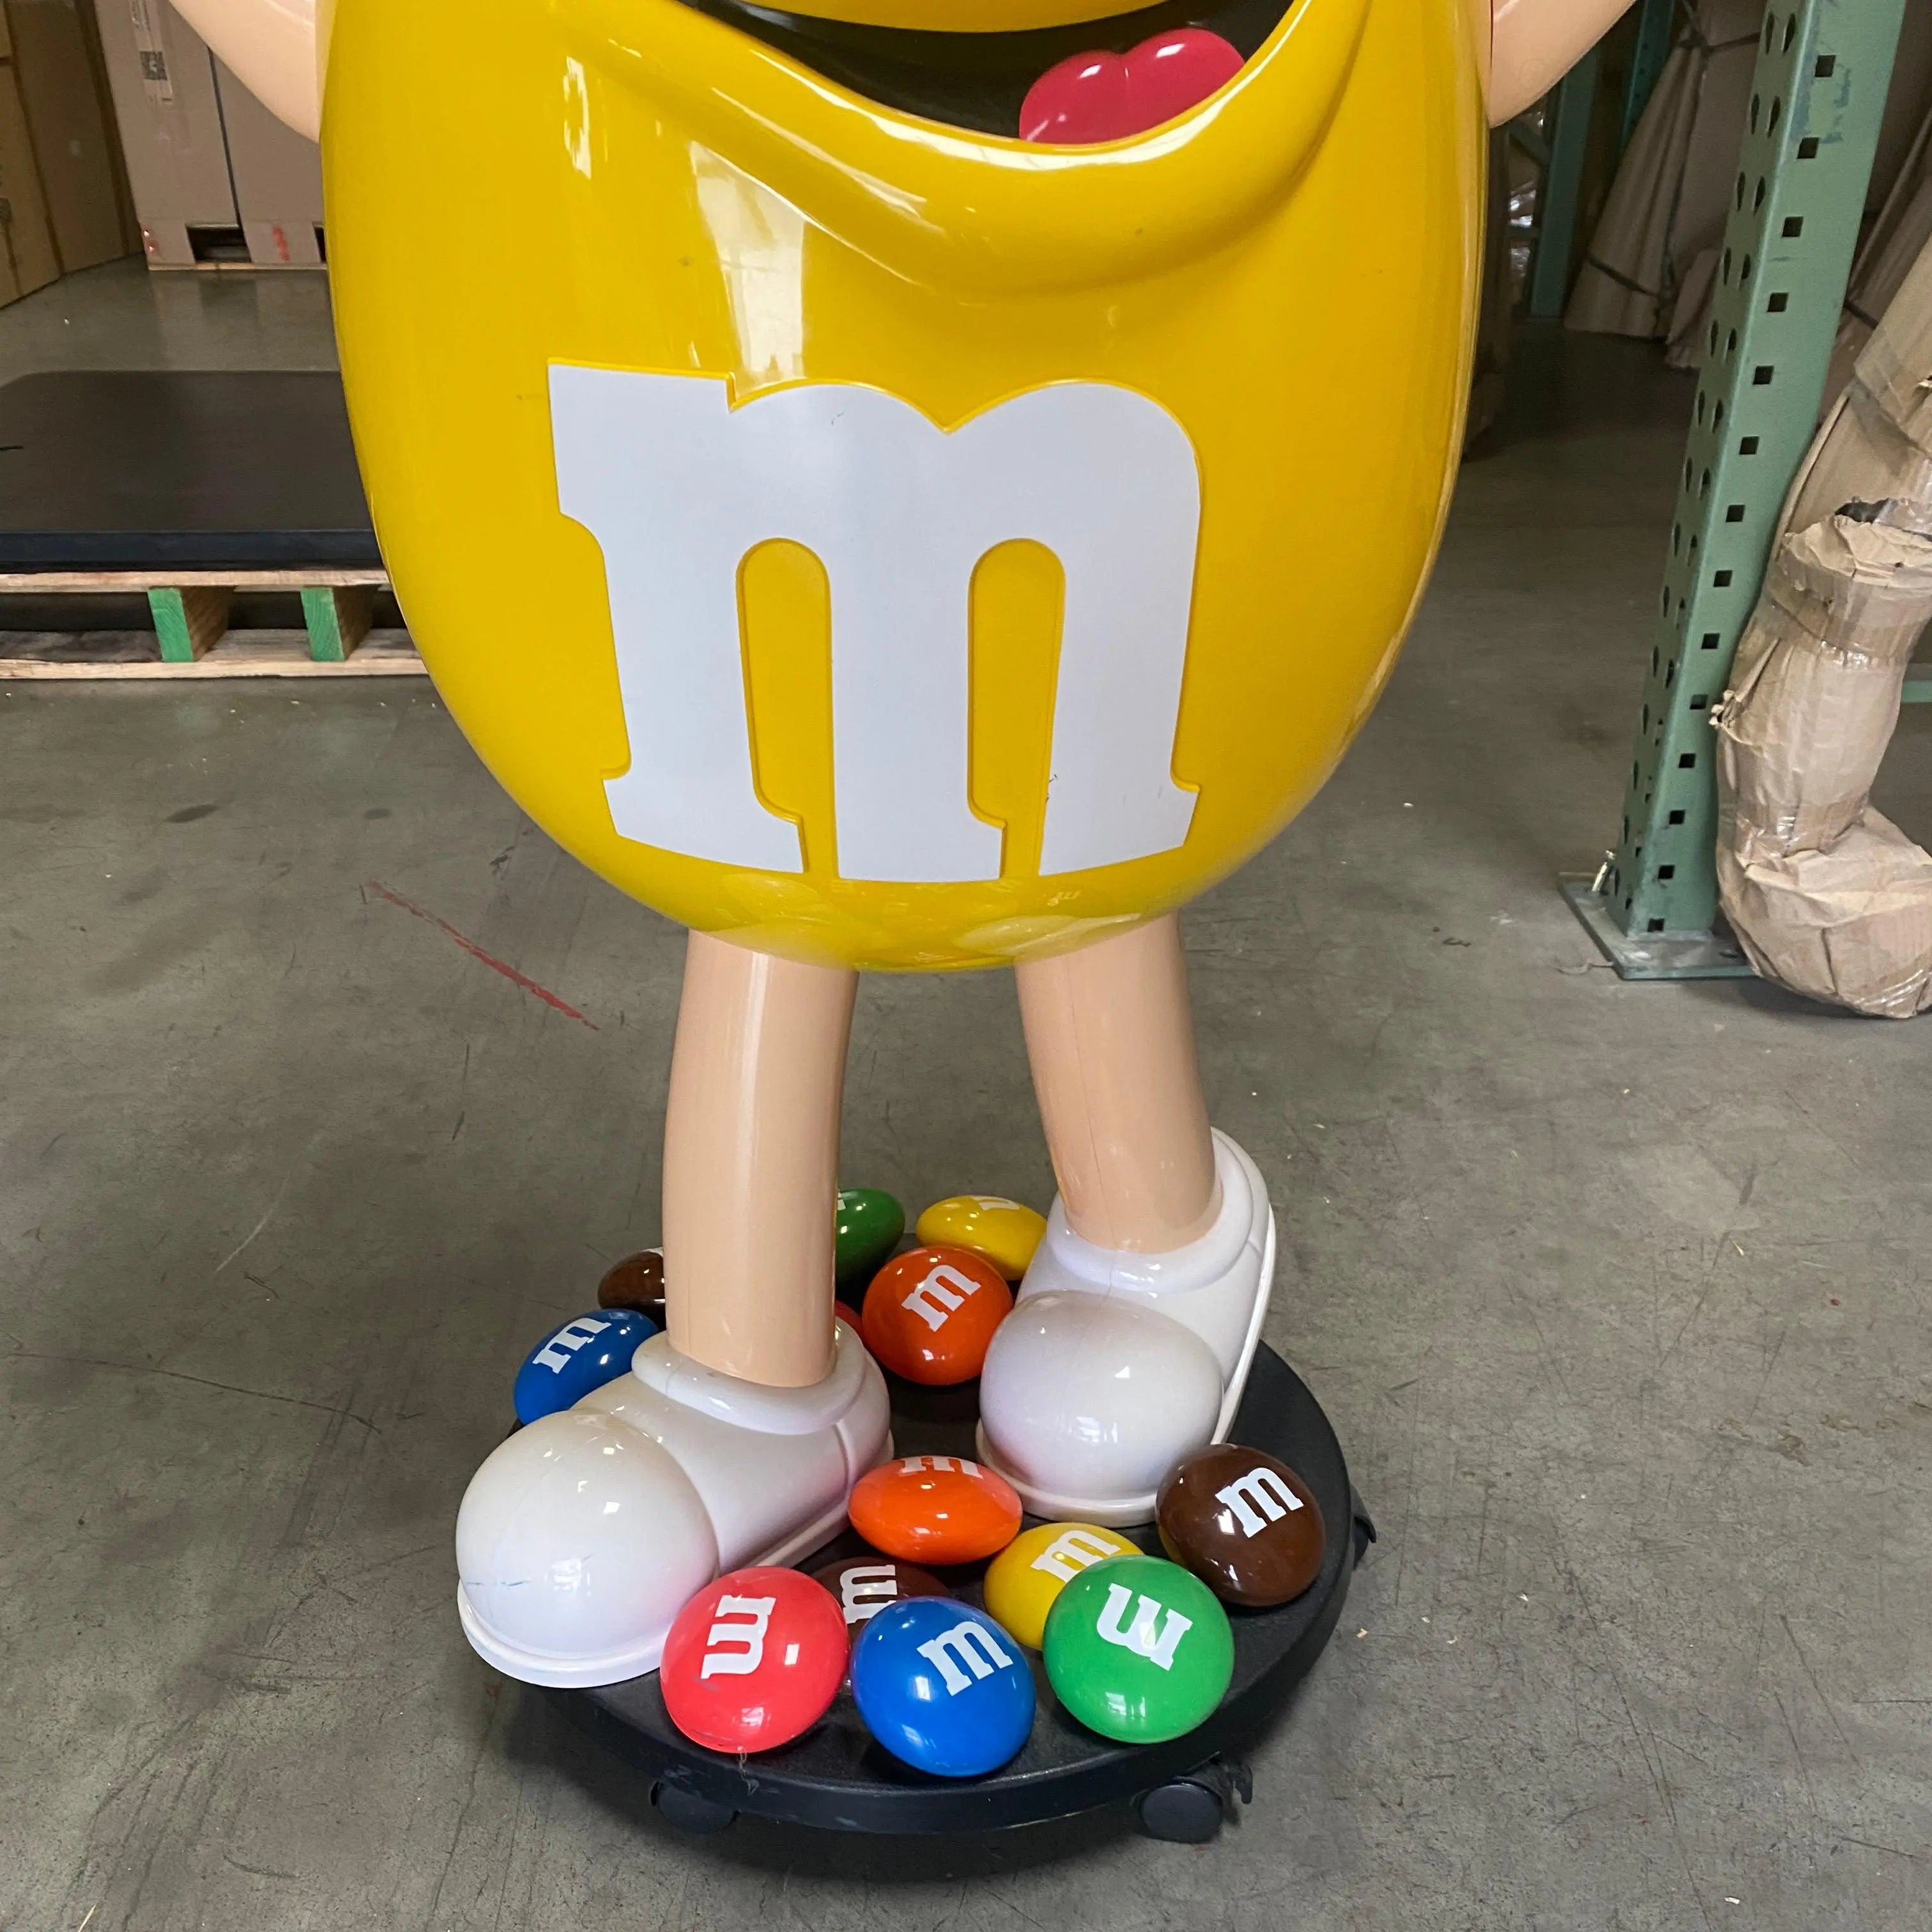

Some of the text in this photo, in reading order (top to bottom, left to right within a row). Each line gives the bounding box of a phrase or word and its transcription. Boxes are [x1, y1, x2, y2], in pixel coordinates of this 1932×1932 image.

[548, 364, 1200, 883] m
[901, 1264, 981, 1332] m
[532, 1317, 612, 1374] m
[1215, 1467, 1304, 1538] m
[1031, 1529, 1121, 1583] m
[700, 1594, 777, 1680] m
[917, 1620, 1014, 1696] m
[1096, 1582, 1193, 1671] m
